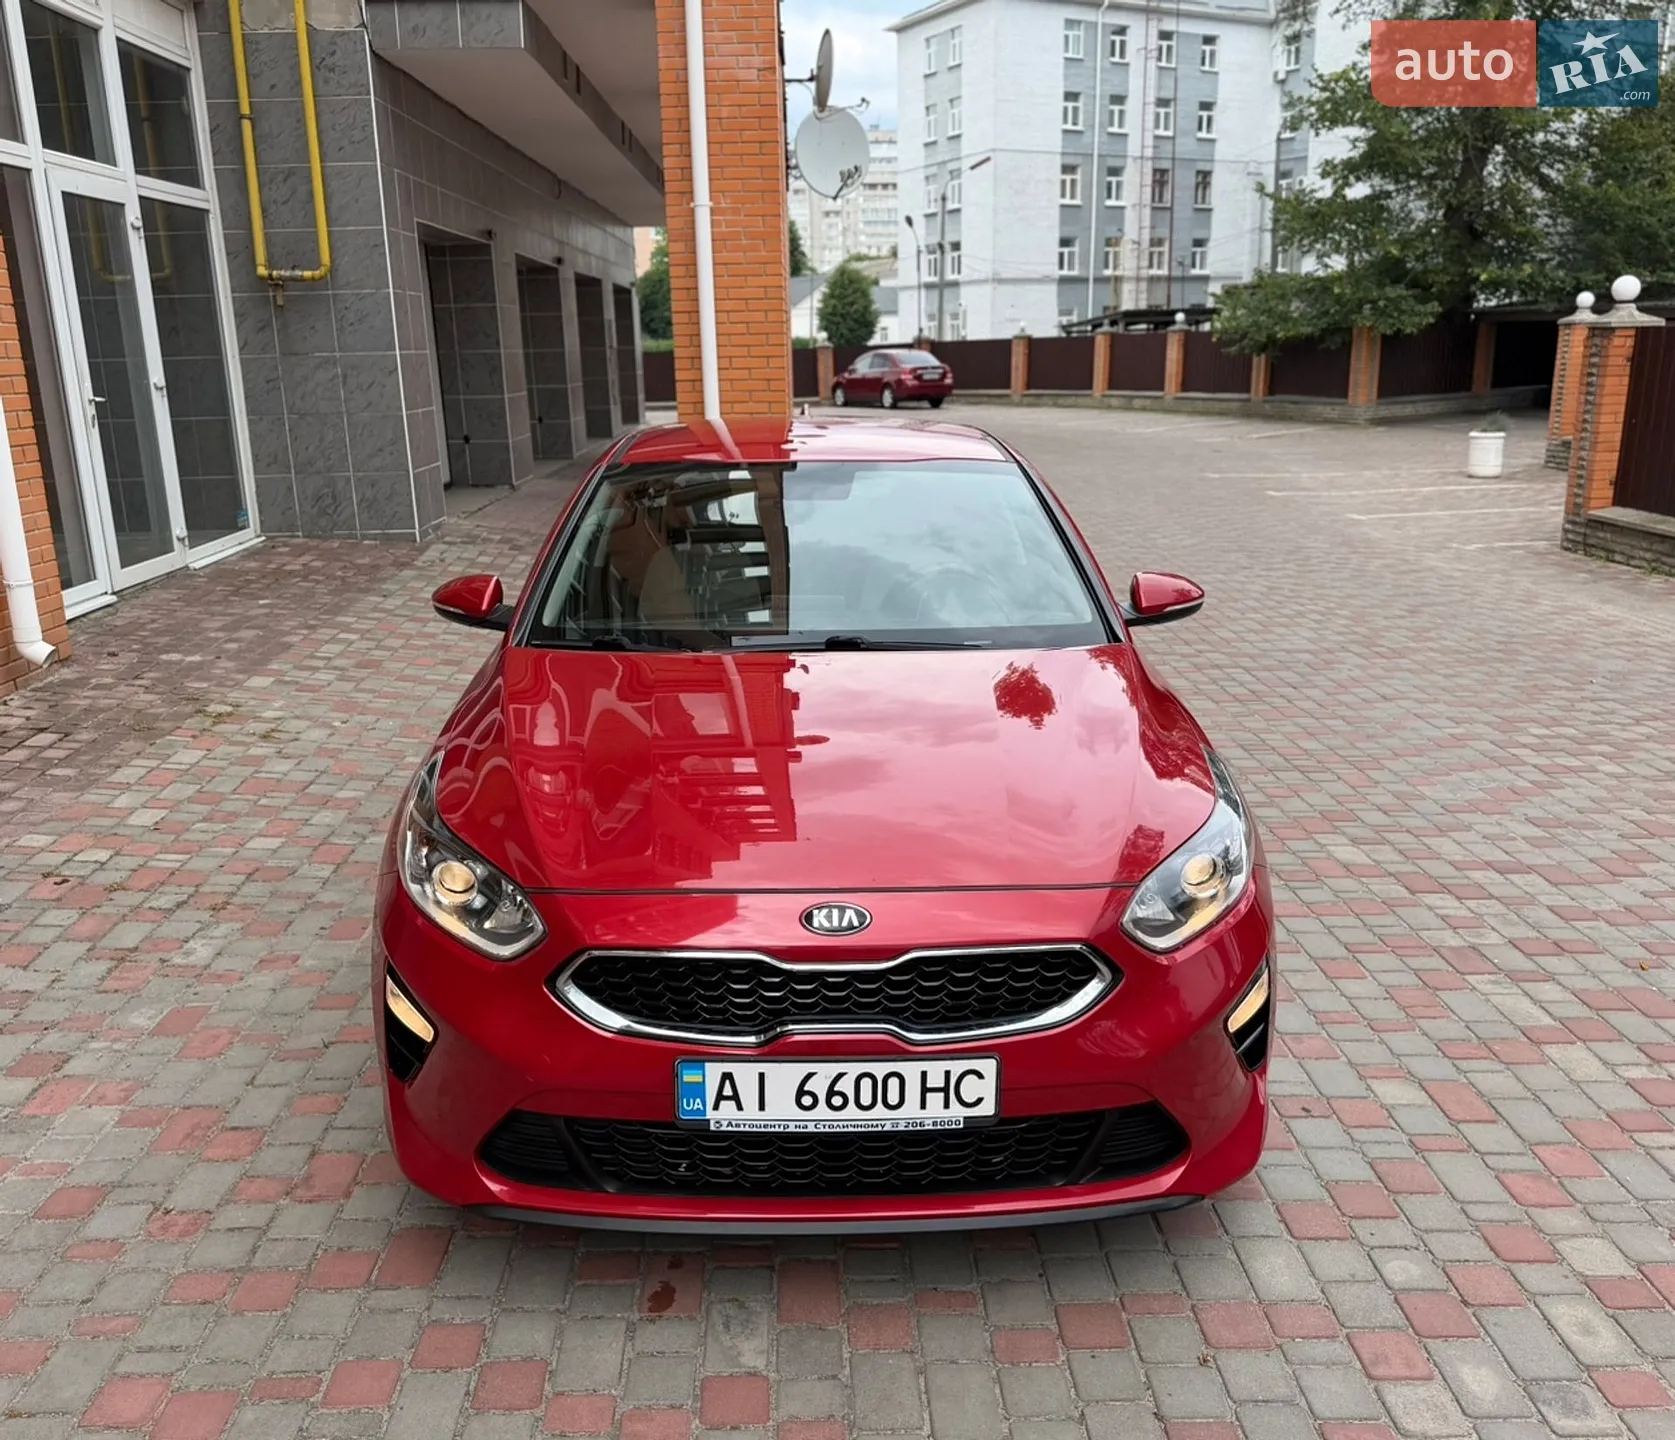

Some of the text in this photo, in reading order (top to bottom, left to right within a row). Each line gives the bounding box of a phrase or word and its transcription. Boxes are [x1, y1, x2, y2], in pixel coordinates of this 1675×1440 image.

[812, 908, 860, 928] KIA
[712, 1068, 986, 1112] AI 6600 HC
[682, 1097, 704, 1111] UA
[725, 1120, 790, 1131] Автоцентр
[813, 1122, 887, 1131] Столичному
[903, 1118, 961, 1129] 206-8000
